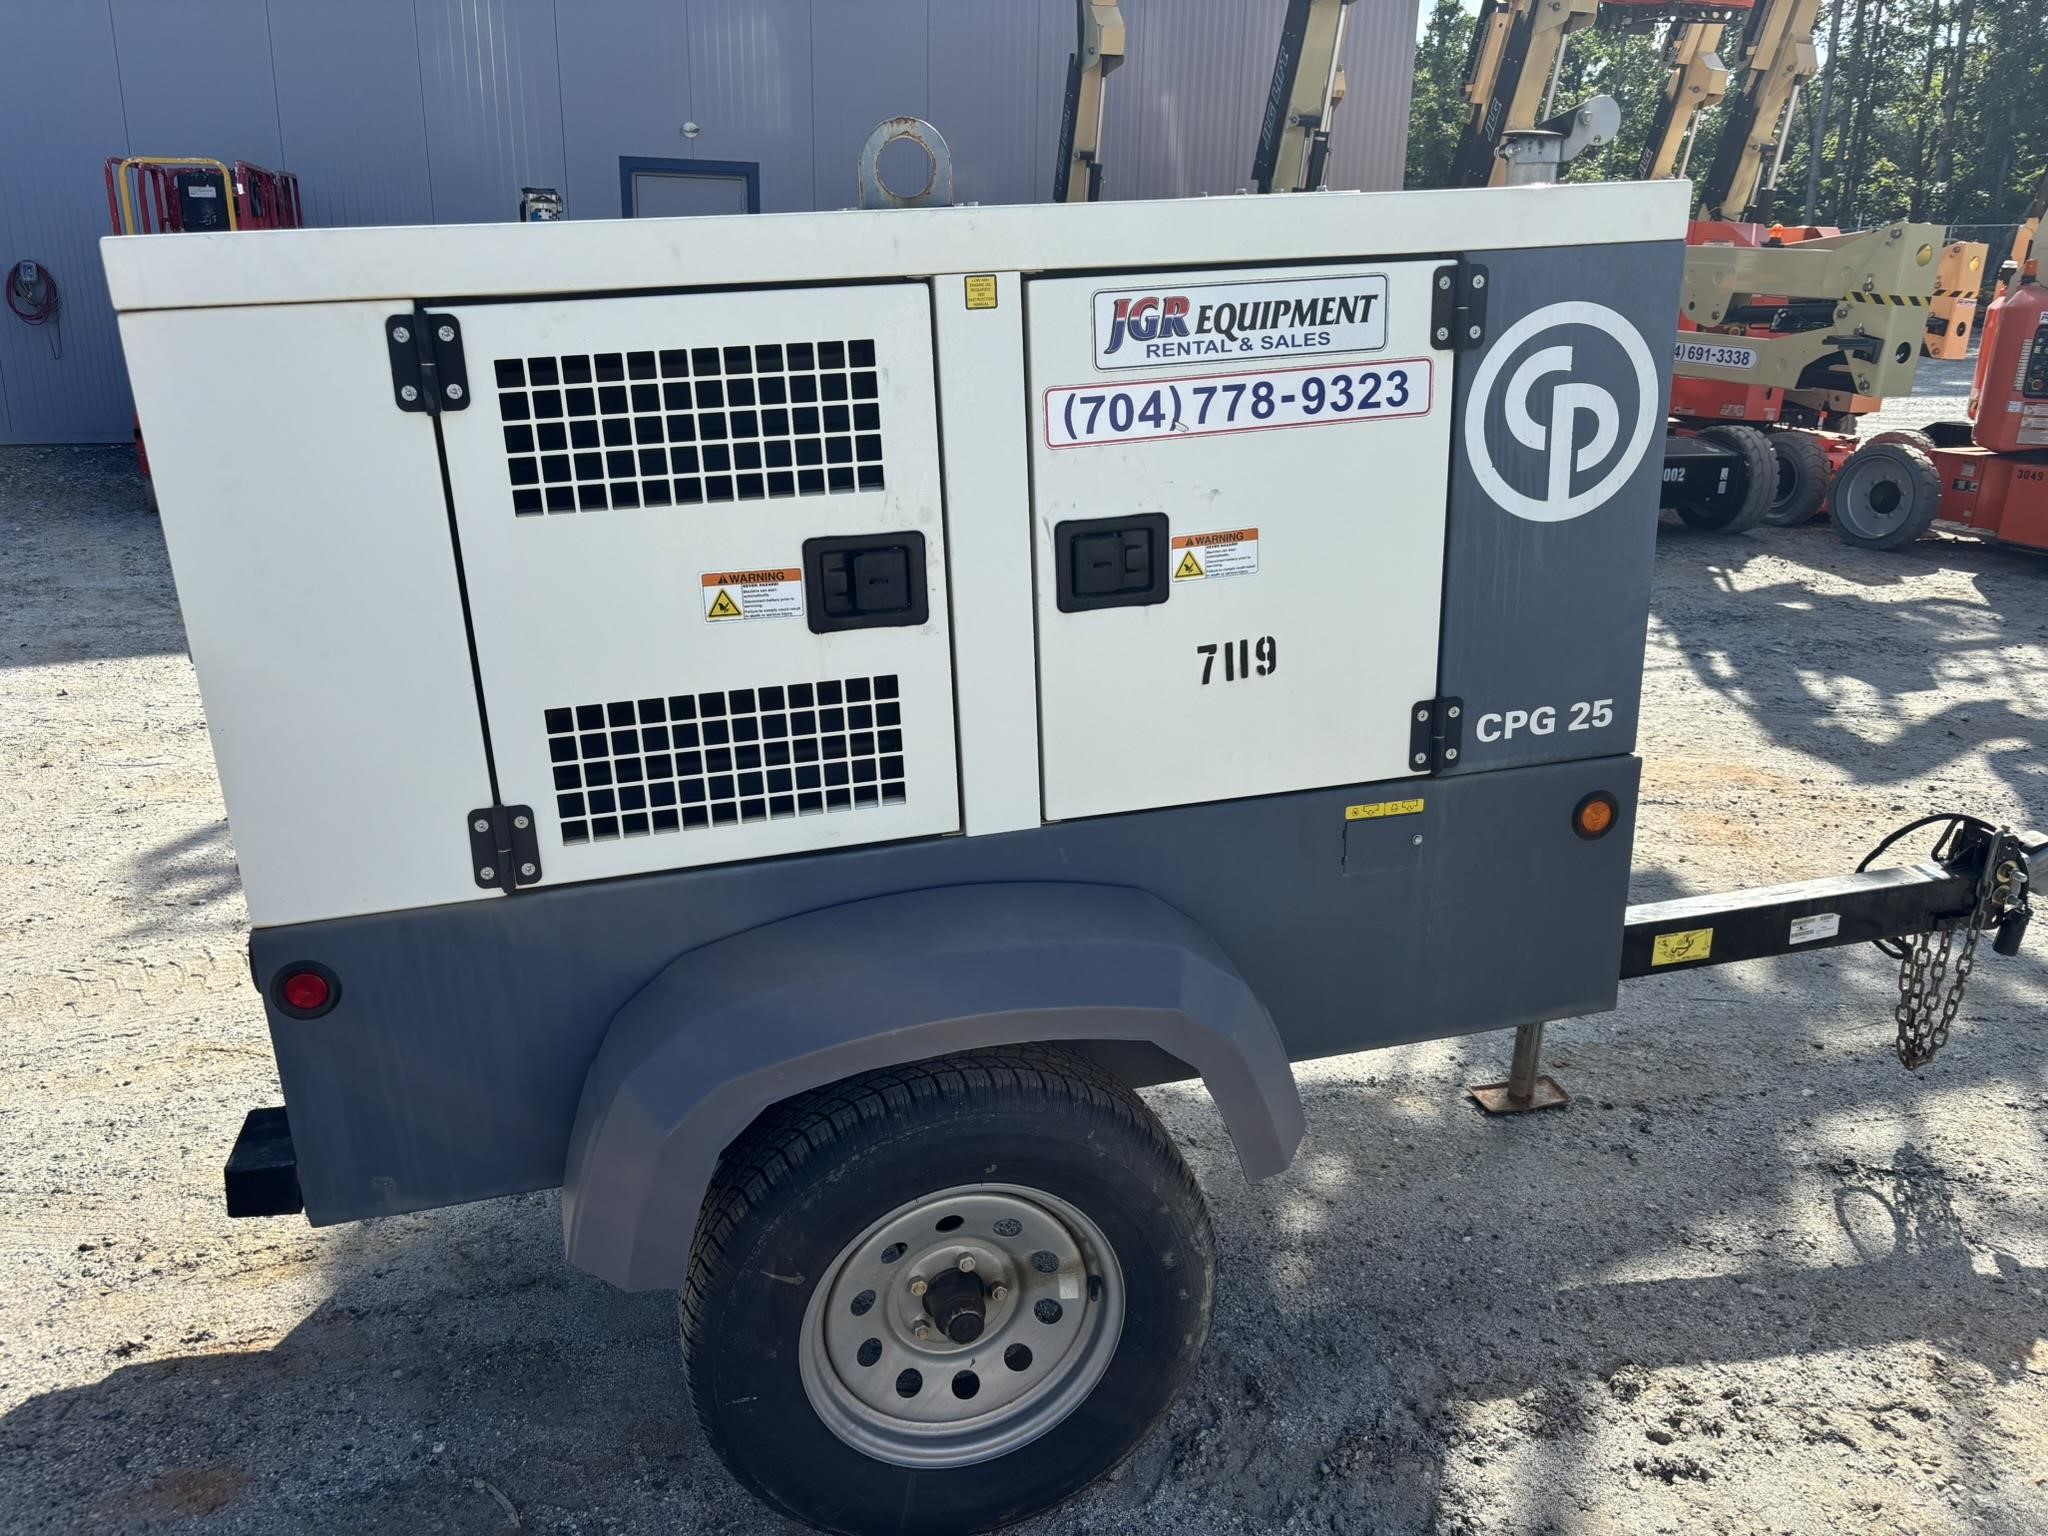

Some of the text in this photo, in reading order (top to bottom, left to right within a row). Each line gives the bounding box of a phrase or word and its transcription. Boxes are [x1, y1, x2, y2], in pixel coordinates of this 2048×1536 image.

[1485, 96, 1502, 142] JLG
[1104, 293, 1379, 355] JGR EQUIPMENT
[1146, 331, 1331, 359] RENTAL & SALES
[1195, 531, 1244, 545] WARNING
[729, 571, 785, 584] WARNING
[1197, 635, 1277, 685] 7119
[1475, 698, 1614, 743] CPG 25
